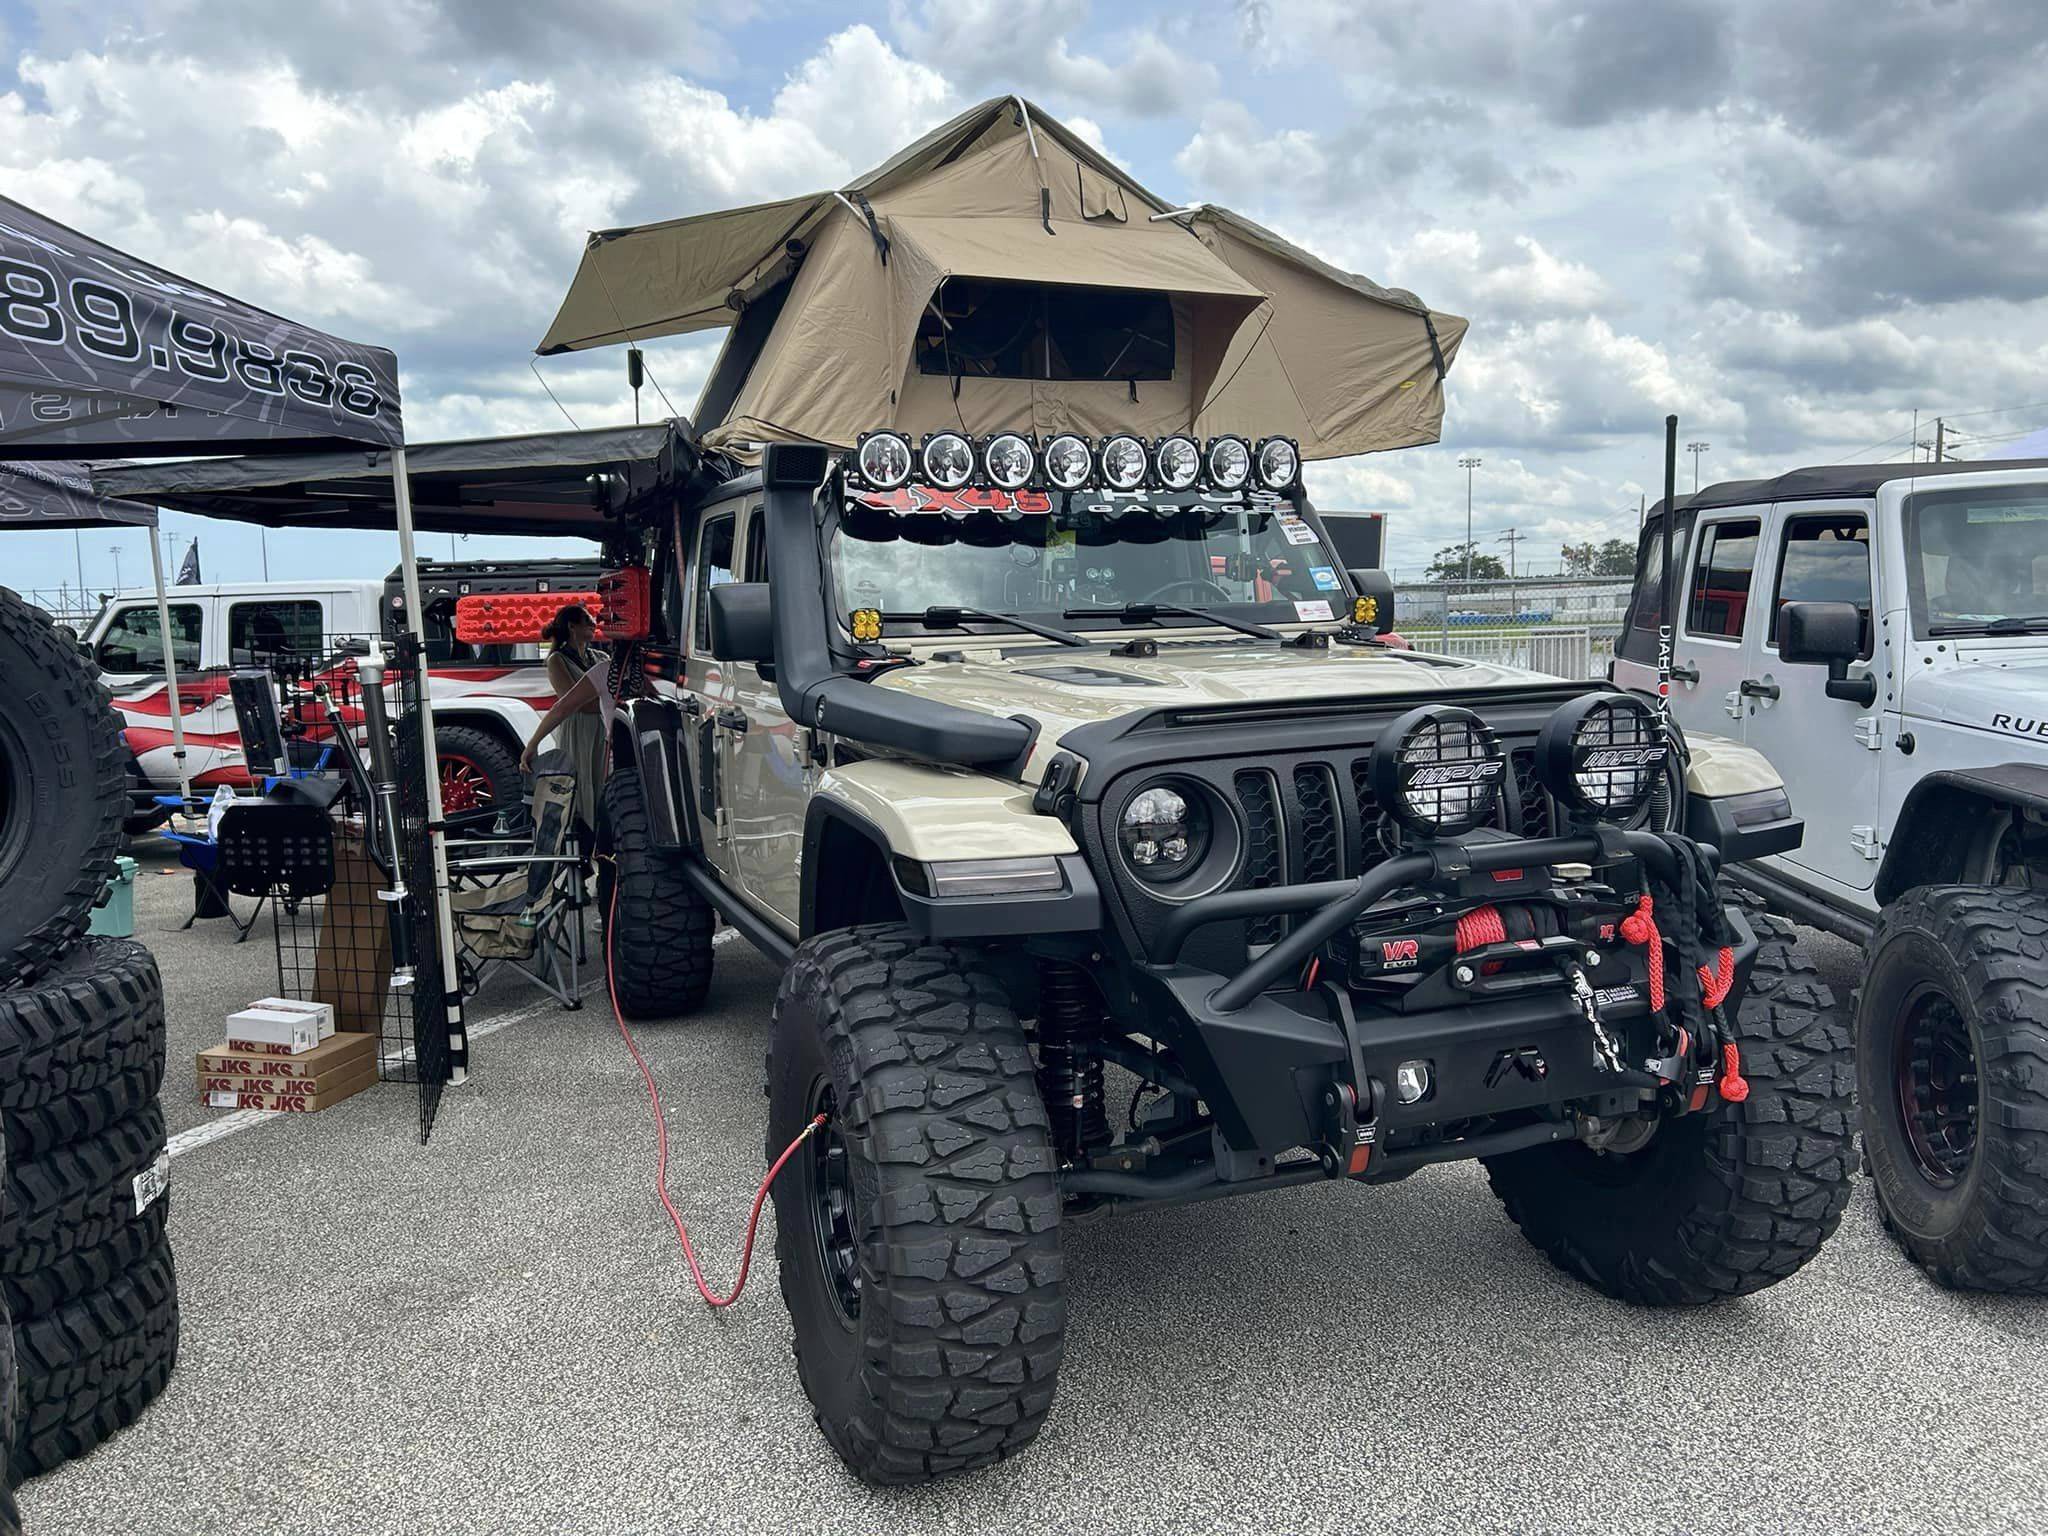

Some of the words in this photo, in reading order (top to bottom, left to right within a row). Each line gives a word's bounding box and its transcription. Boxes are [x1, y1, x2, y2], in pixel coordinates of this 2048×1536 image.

[1087, 504, 1275, 513] GARAGE
[1383, 939, 1419, 961] VR
[217, 1059, 251, 1075] JKS
[257, 1061, 293, 1077] JKS
[207, 1078, 232, 1091] KS
[238, 1079, 275, 1094] JKS
[280, 1081, 317, 1095] JKS
[237, 1094, 264, 1110] KS
[270, 1095, 306, 1112] JKS
